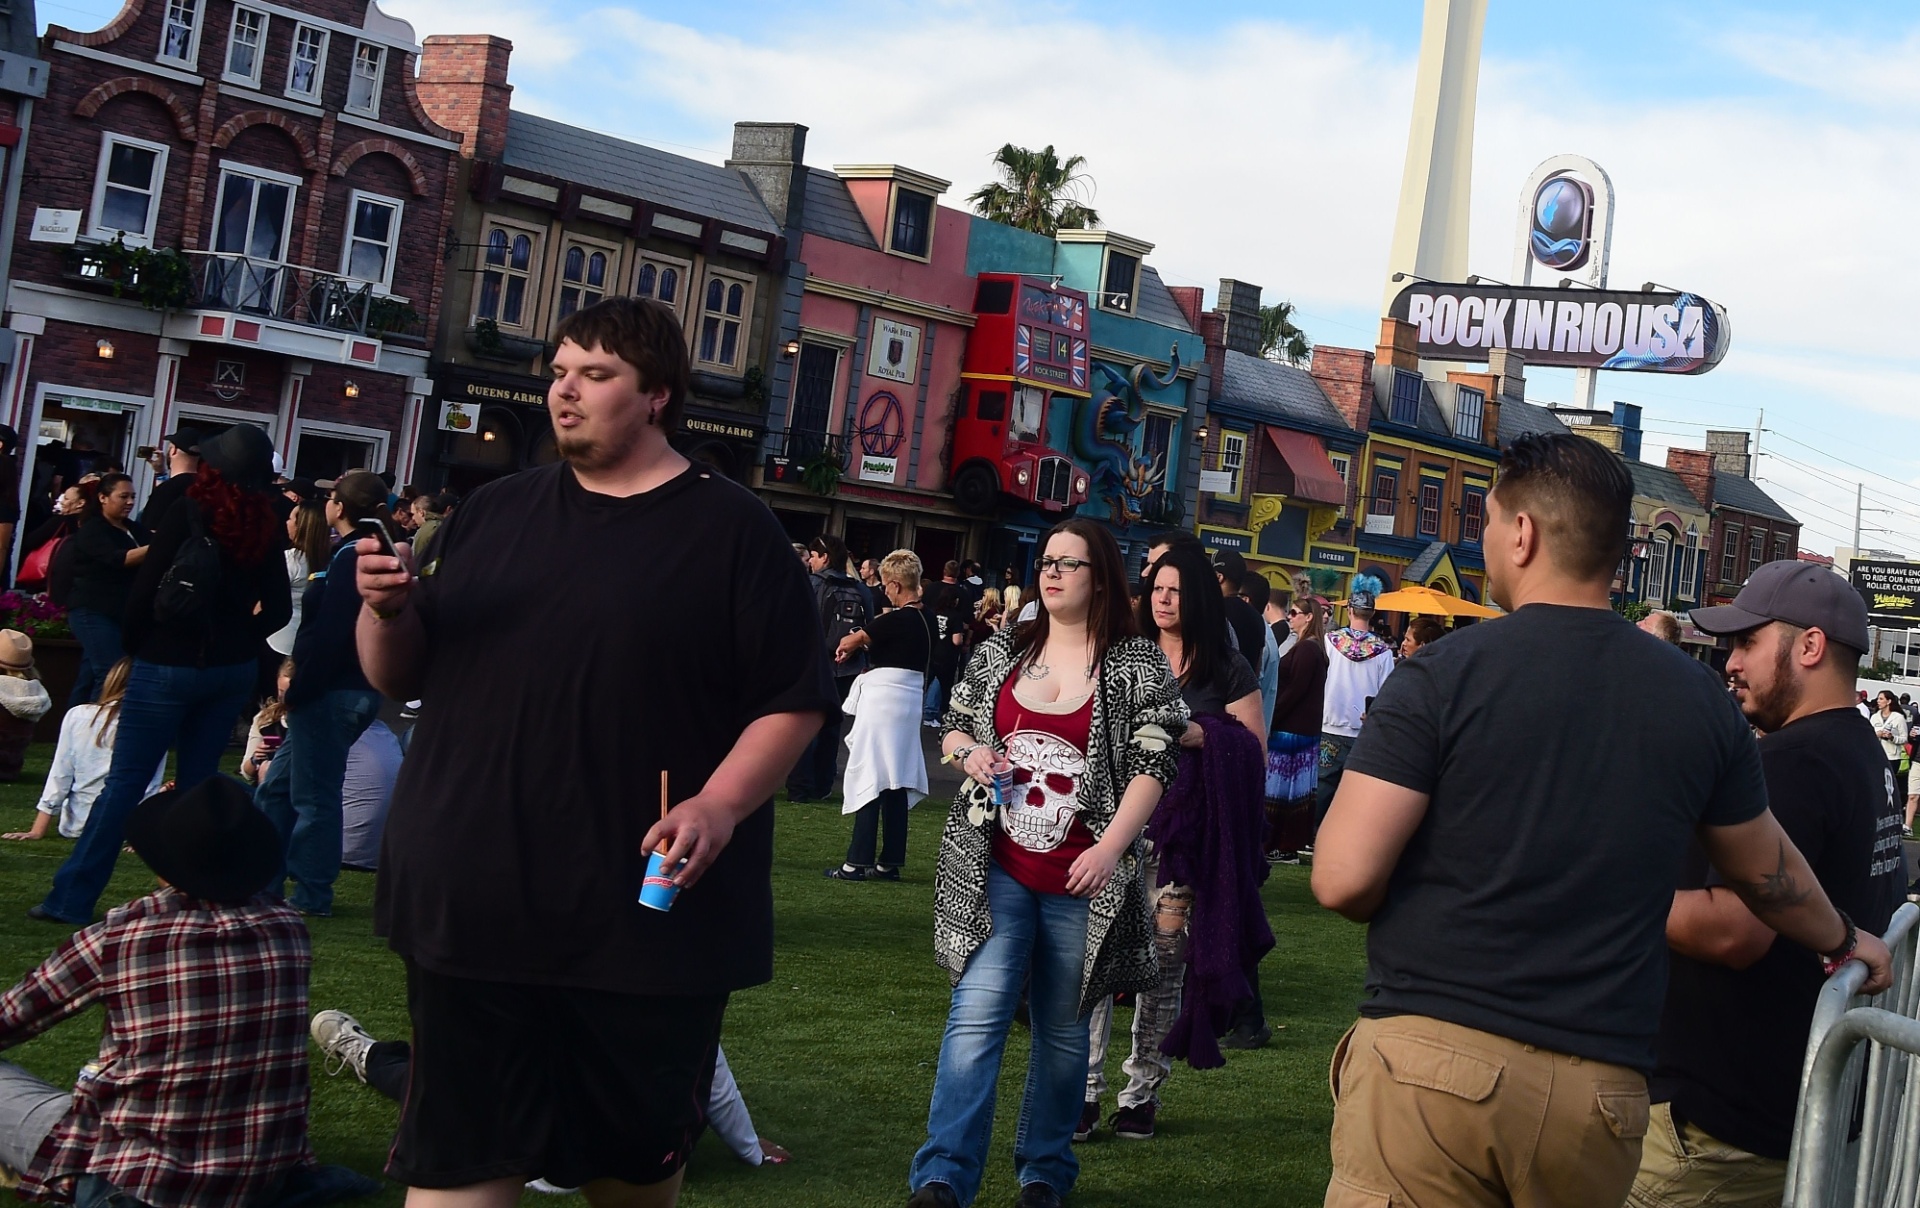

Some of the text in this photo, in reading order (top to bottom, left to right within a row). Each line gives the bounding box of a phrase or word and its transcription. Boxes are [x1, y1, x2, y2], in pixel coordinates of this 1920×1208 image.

[1057, 340, 1068, 358] 14
[1034, 365, 1067, 380] ROCK STREET
[467, 384, 544, 405] QUEENS ARMS
[686, 419, 754, 438] QUEENS ARMS
[1211, 536, 1241, 547] LOCKERS
[1318, 551, 1345, 563] LOCKERS
[1887, 568, 1907, 576] BRAVE
[1862, 573, 1920, 585] TO RIDE OUR NEW
[1866, 582, 1891, 590] ROLLER
